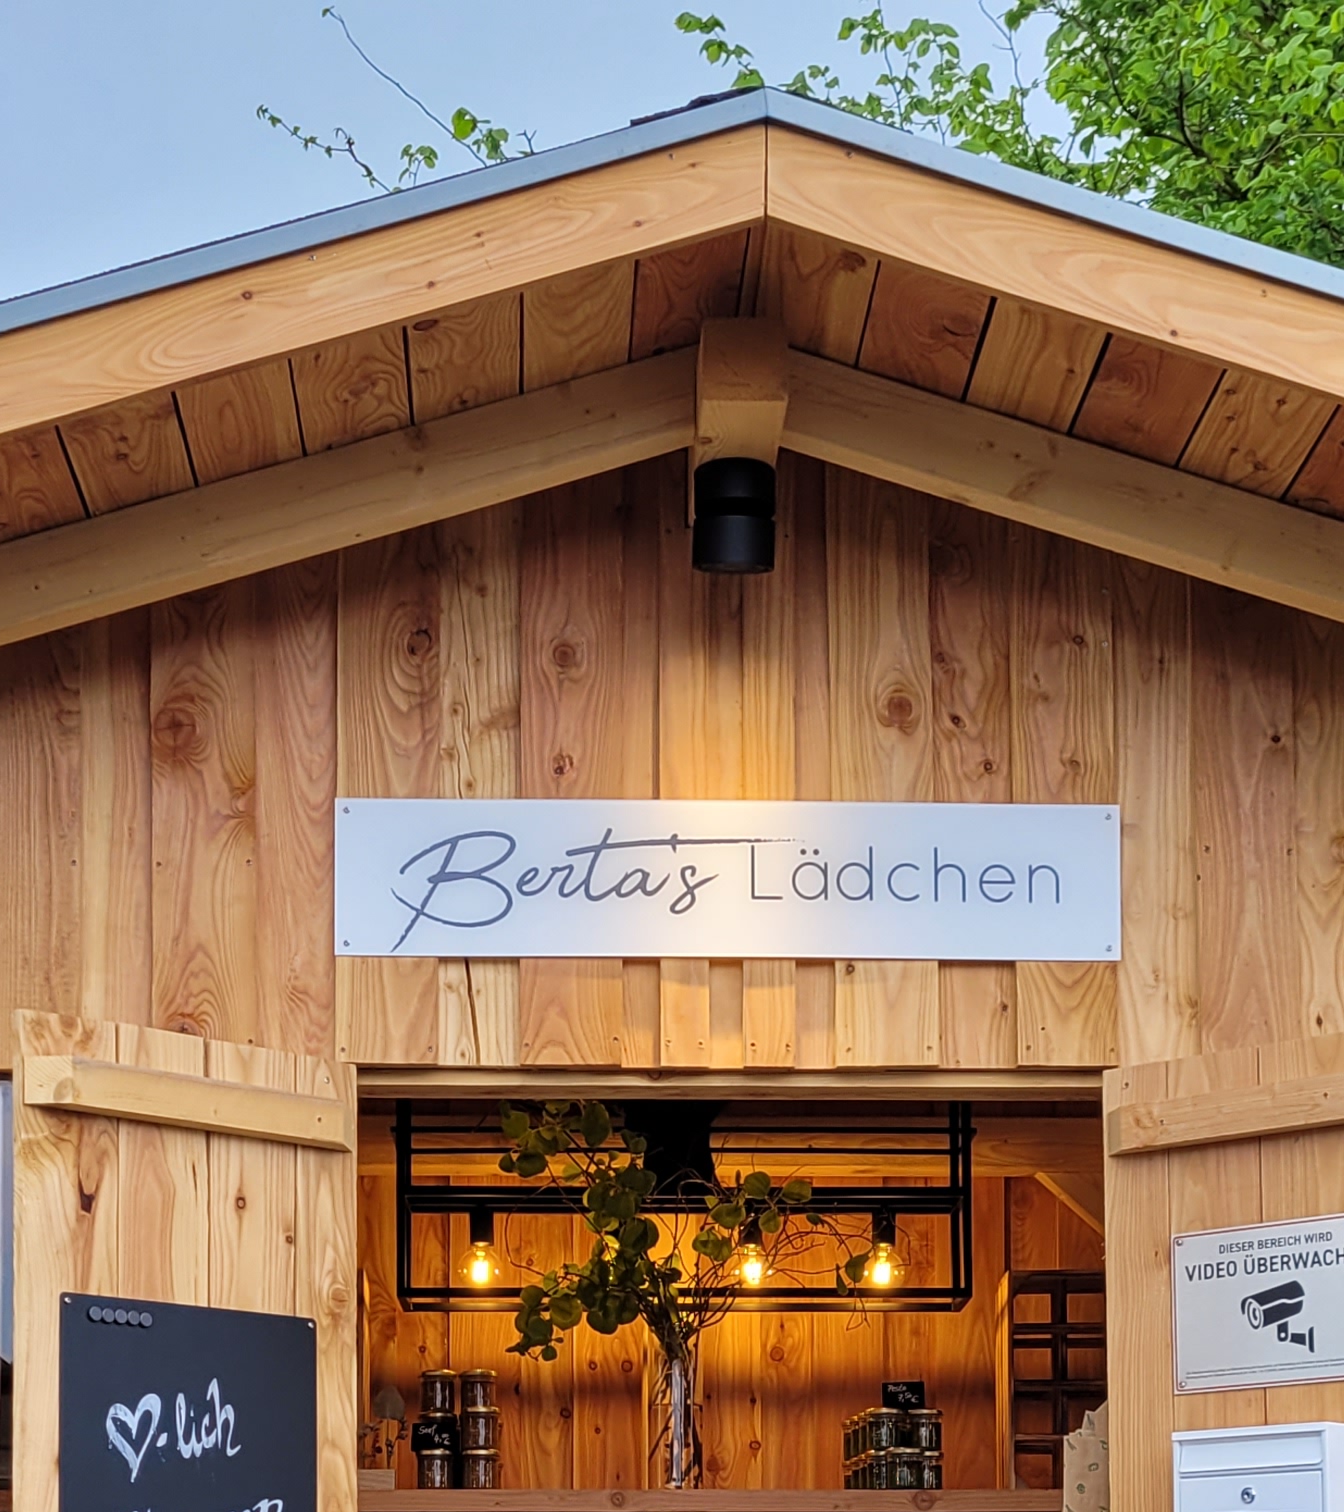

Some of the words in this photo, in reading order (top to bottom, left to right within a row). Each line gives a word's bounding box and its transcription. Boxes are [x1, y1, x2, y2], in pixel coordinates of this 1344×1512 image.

[747, 845, 1063, 905] Lädchen
[1218, 1241, 1255, 1254] DIESER
[1257, 1235, 1302, 1251] BEREICH
[1304, 1231, 1333, 1244] WIRD
[1184, 1260, 1238, 1282] VIDEO
